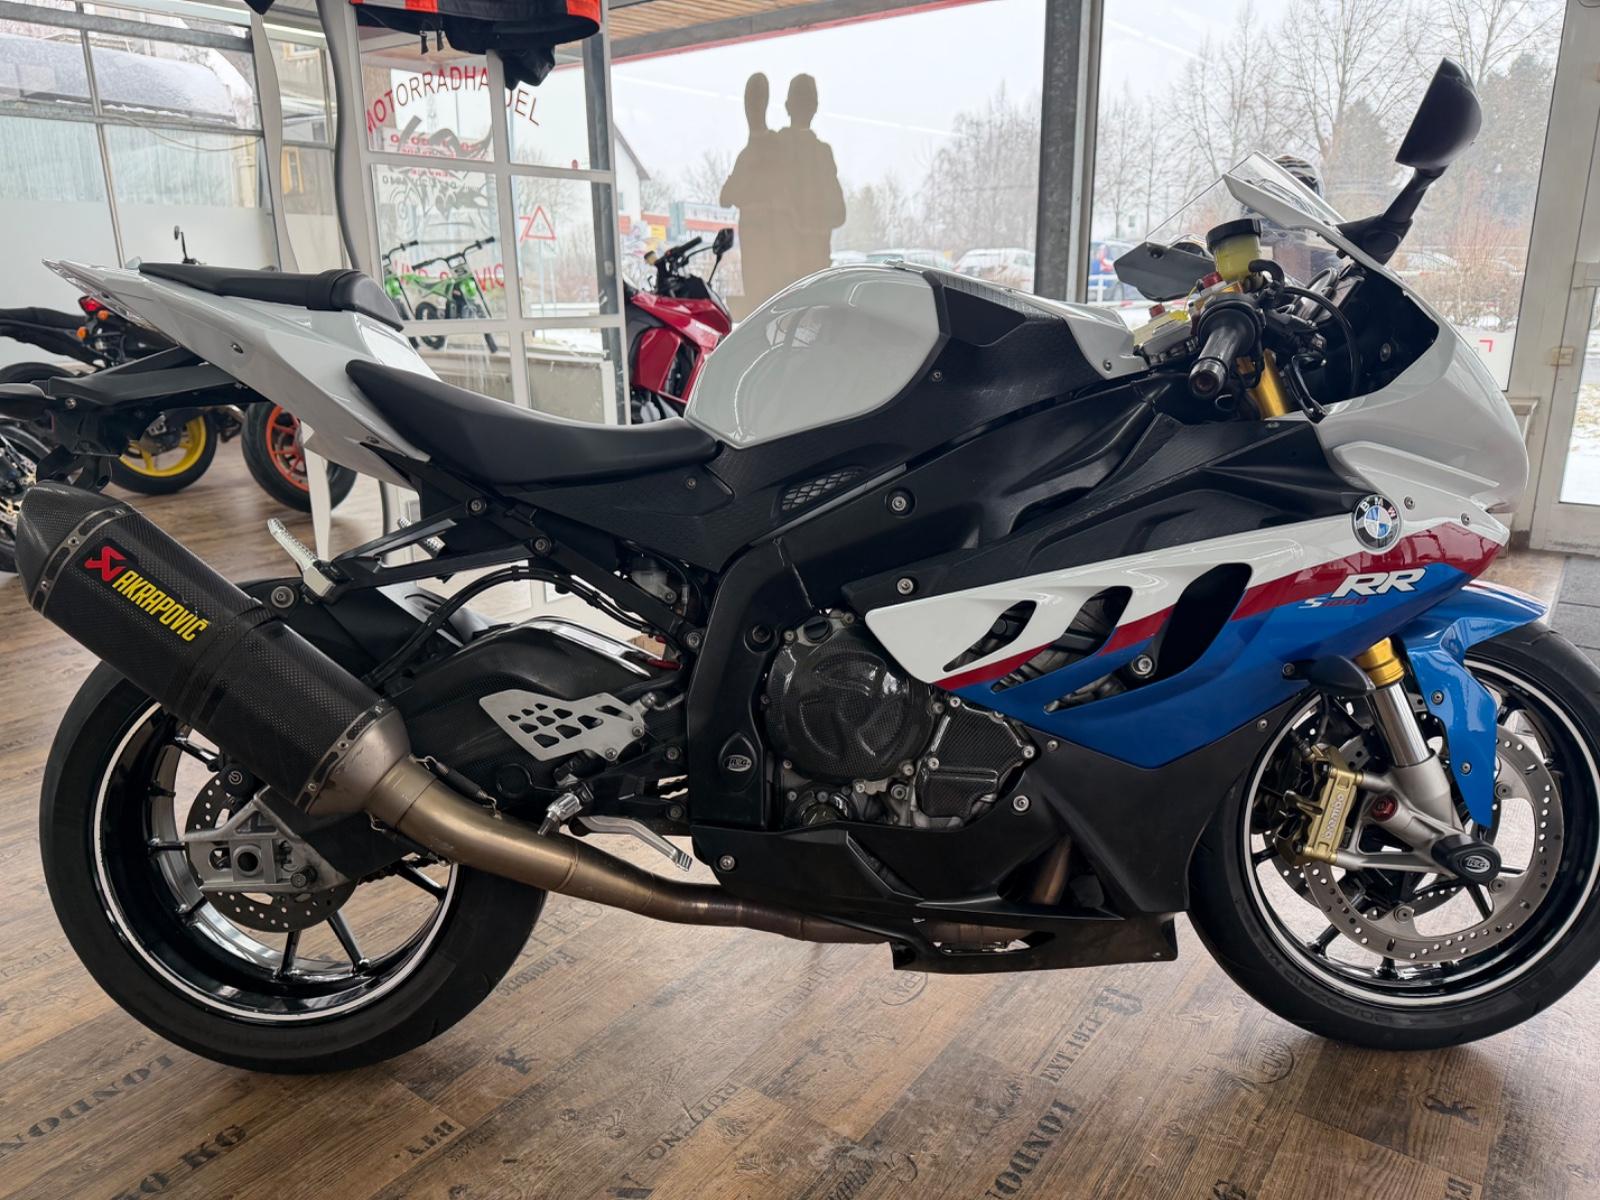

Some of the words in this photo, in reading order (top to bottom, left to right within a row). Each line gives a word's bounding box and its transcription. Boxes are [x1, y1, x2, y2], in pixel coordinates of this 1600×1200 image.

[366, 65, 540, 135] MOTORRADHAEL
[1360, 497, 1398, 520] BMW
[112, 570, 209, 642] AKRAPOVIČ
[1331, 568, 1426, 598] RR
[1321, 793, 1344, 841] brembo
